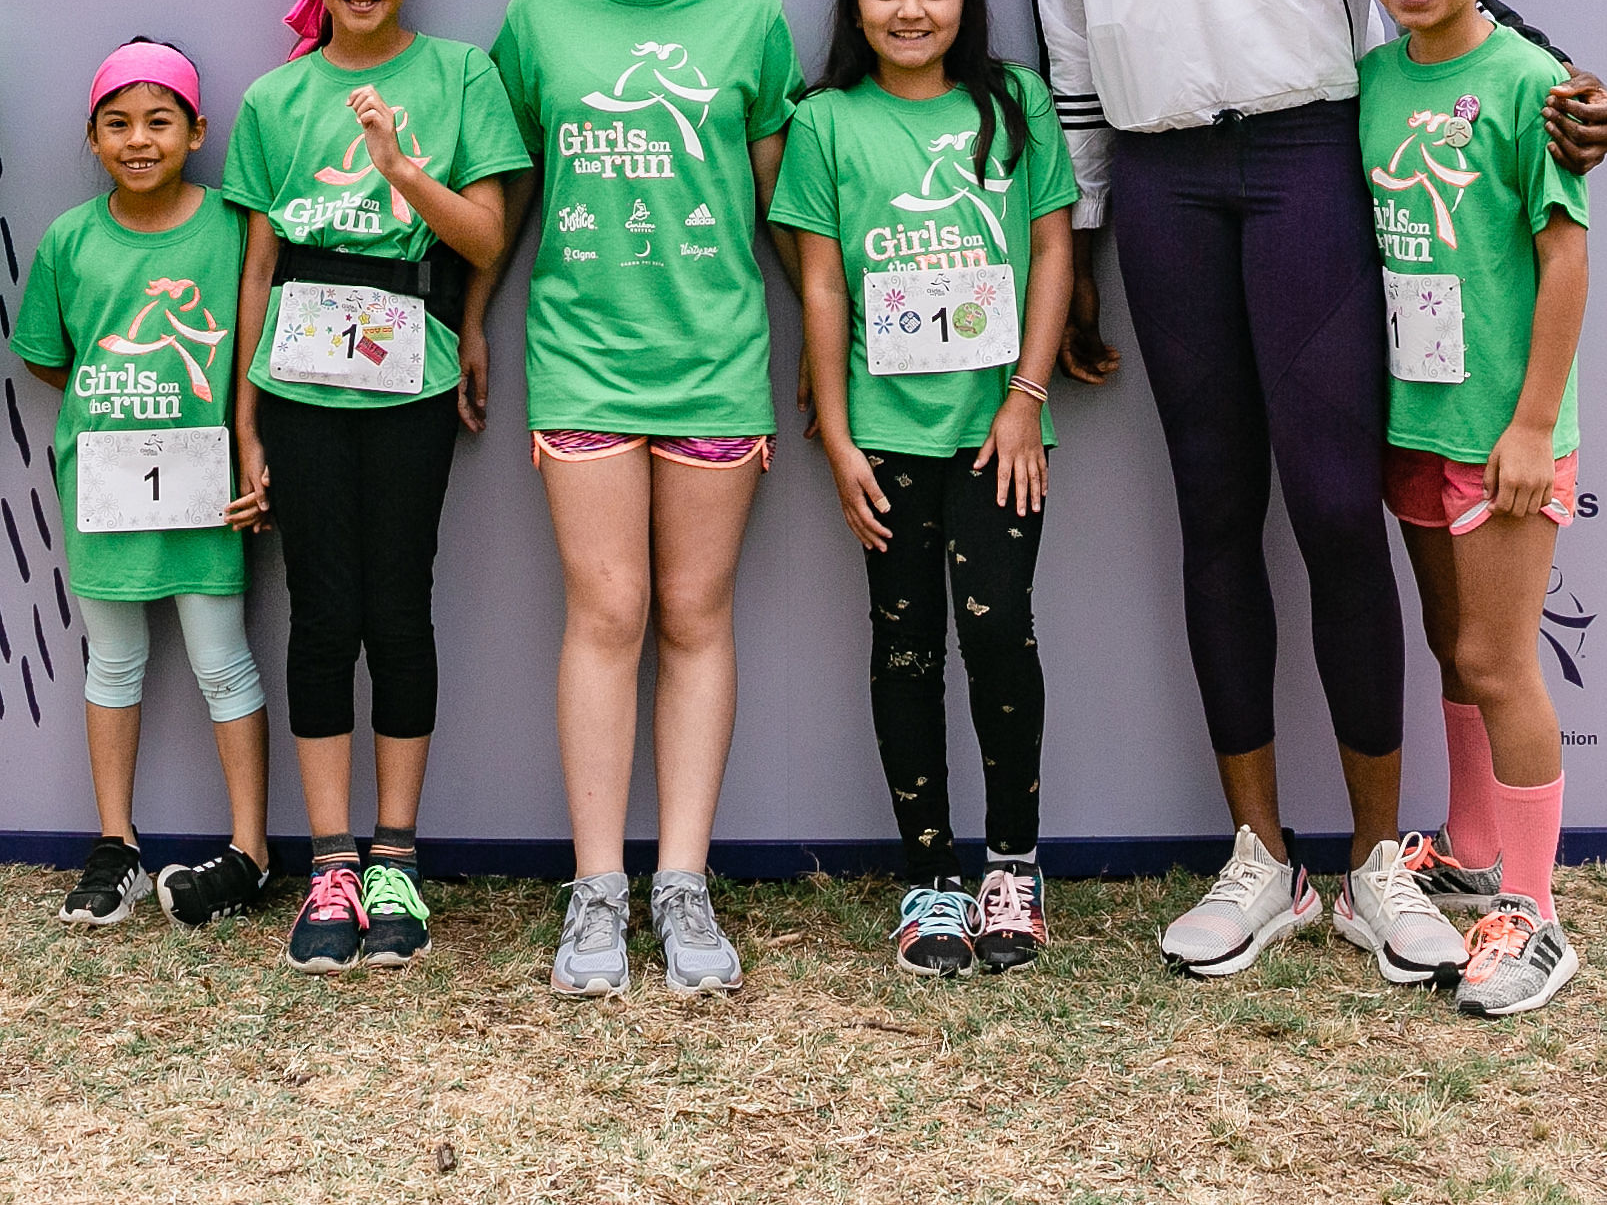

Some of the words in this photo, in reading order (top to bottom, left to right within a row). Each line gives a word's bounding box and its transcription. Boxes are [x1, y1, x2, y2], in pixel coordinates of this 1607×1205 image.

[558, 121, 647, 156] Girls
[648, 141, 671, 153] on
[573, 157, 601, 174] the
[600, 154, 675, 179] run
[361, 199, 381, 213] on
[558, 203, 597, 233] Justice
[685, 217, 716, 227] adidas
[1373, 197, 1410, 234] irls
[1408, 222, 1432, 235] on
[864, 220, 962, 261] Girls
[963, 234, 985, 247] on
[914, 247, 988, 272] run
[341, 323, 358, 360] 1
[931, 307, 949, 343] 1
[1390, 311, 1400, 349] 1
[74, 362, 157, 397] Girls
[158, 381, 180, 394] on
[89, 398, 112, 414] he
[110, 394, 183, 420] run
[143, 466, 161, 502] 1
